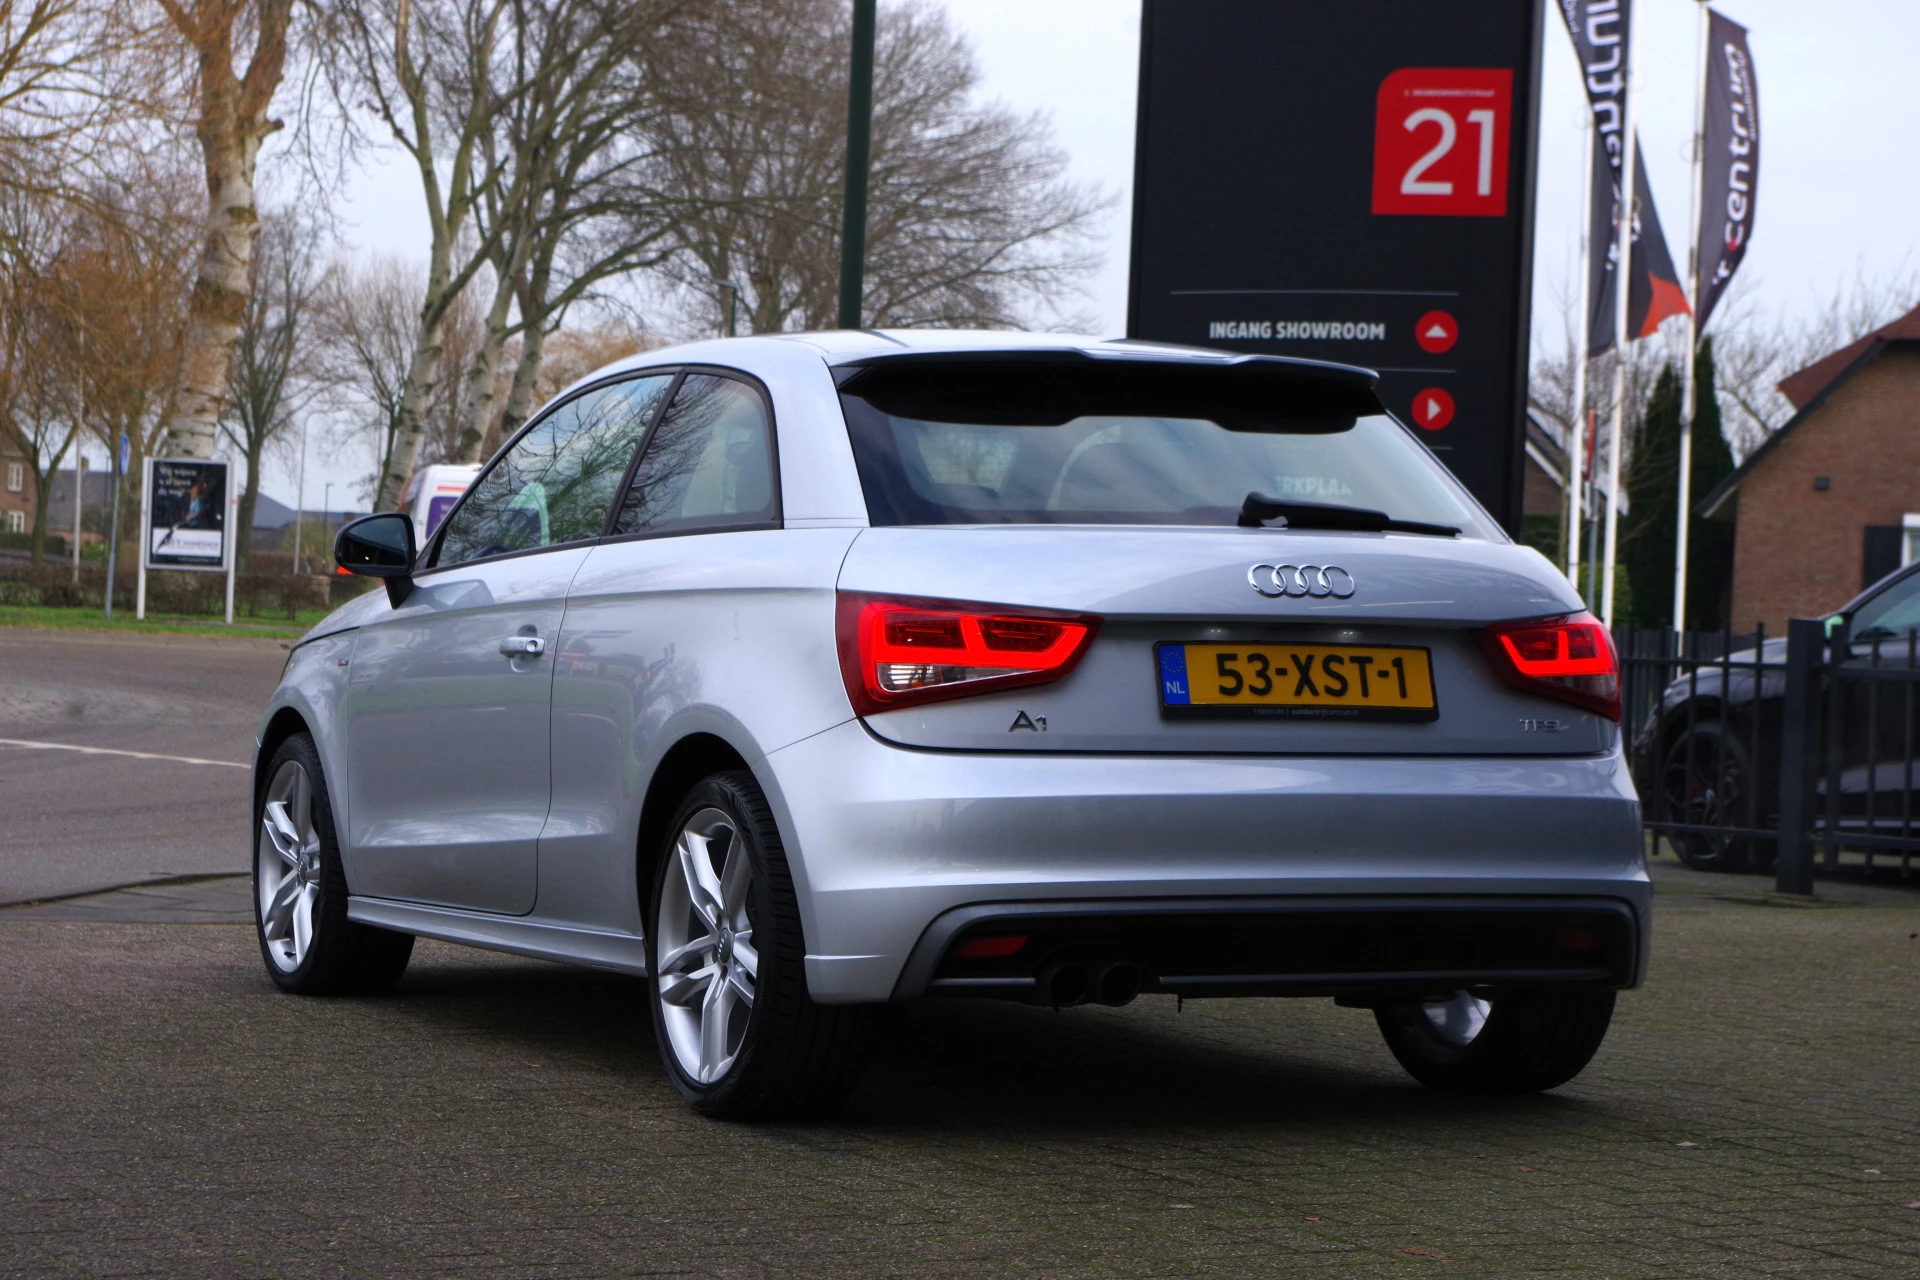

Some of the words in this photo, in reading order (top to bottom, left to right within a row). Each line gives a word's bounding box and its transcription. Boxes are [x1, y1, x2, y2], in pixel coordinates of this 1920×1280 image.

[1400, 108, 1496, 197] 21
[1209, 321, 1272, 339] INGANG
[1276, 322, 1386, 340] SHOWROOM
[1216, 652, 1408, 699] 53-XST-1
[1166, 681, 1186, 694] NL
[1008, 709, 1047, 732] A1
[1519, 718, 1560, 733] TFSI
